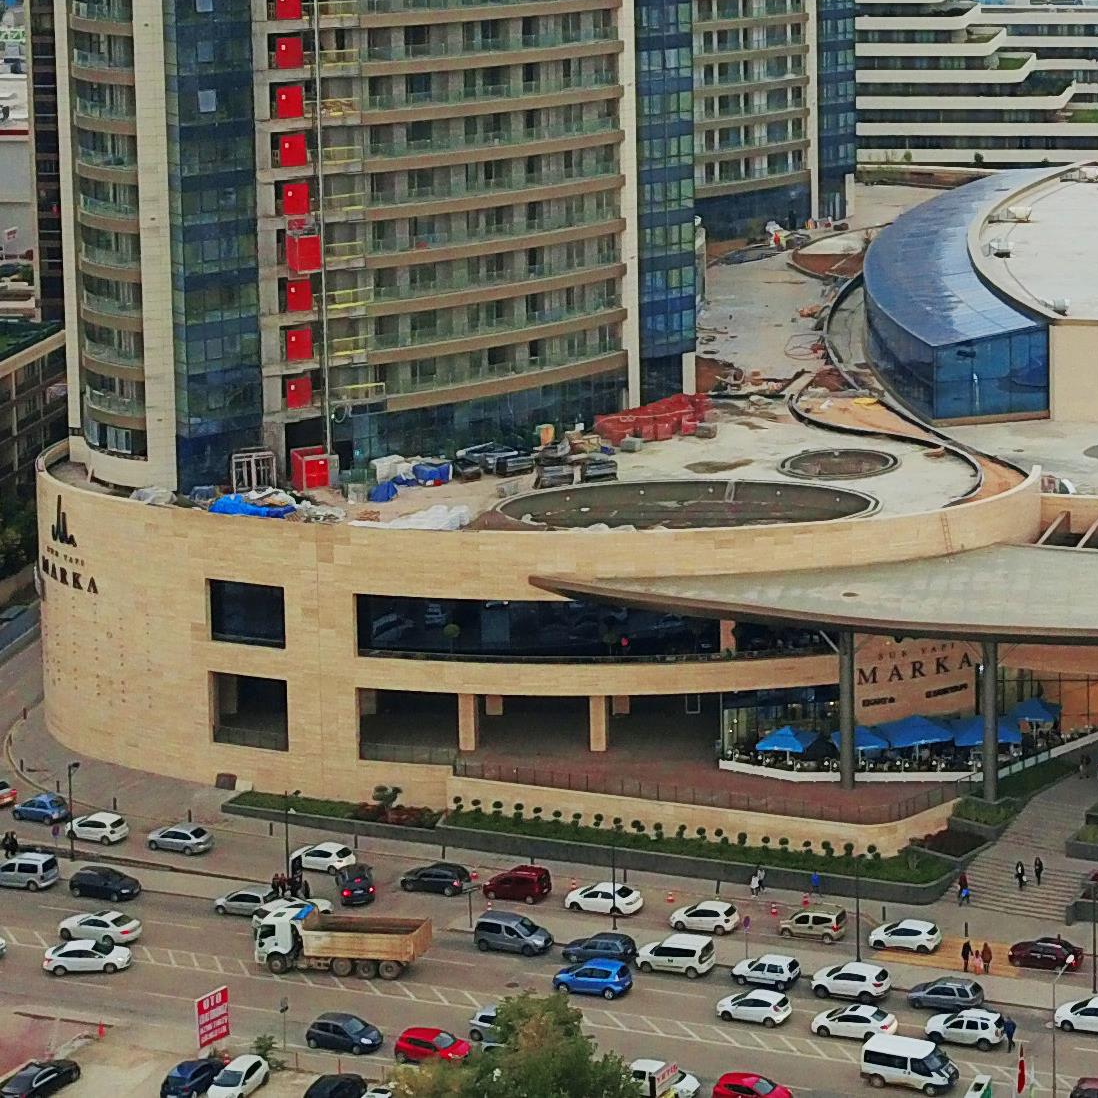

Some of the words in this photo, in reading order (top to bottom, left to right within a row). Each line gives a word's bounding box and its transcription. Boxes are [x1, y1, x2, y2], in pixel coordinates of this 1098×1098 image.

[42, 555, 98, 594] MARKA
[857, 651, 973, 686] MARKA
[202, 991, 222, 1011] OTO
